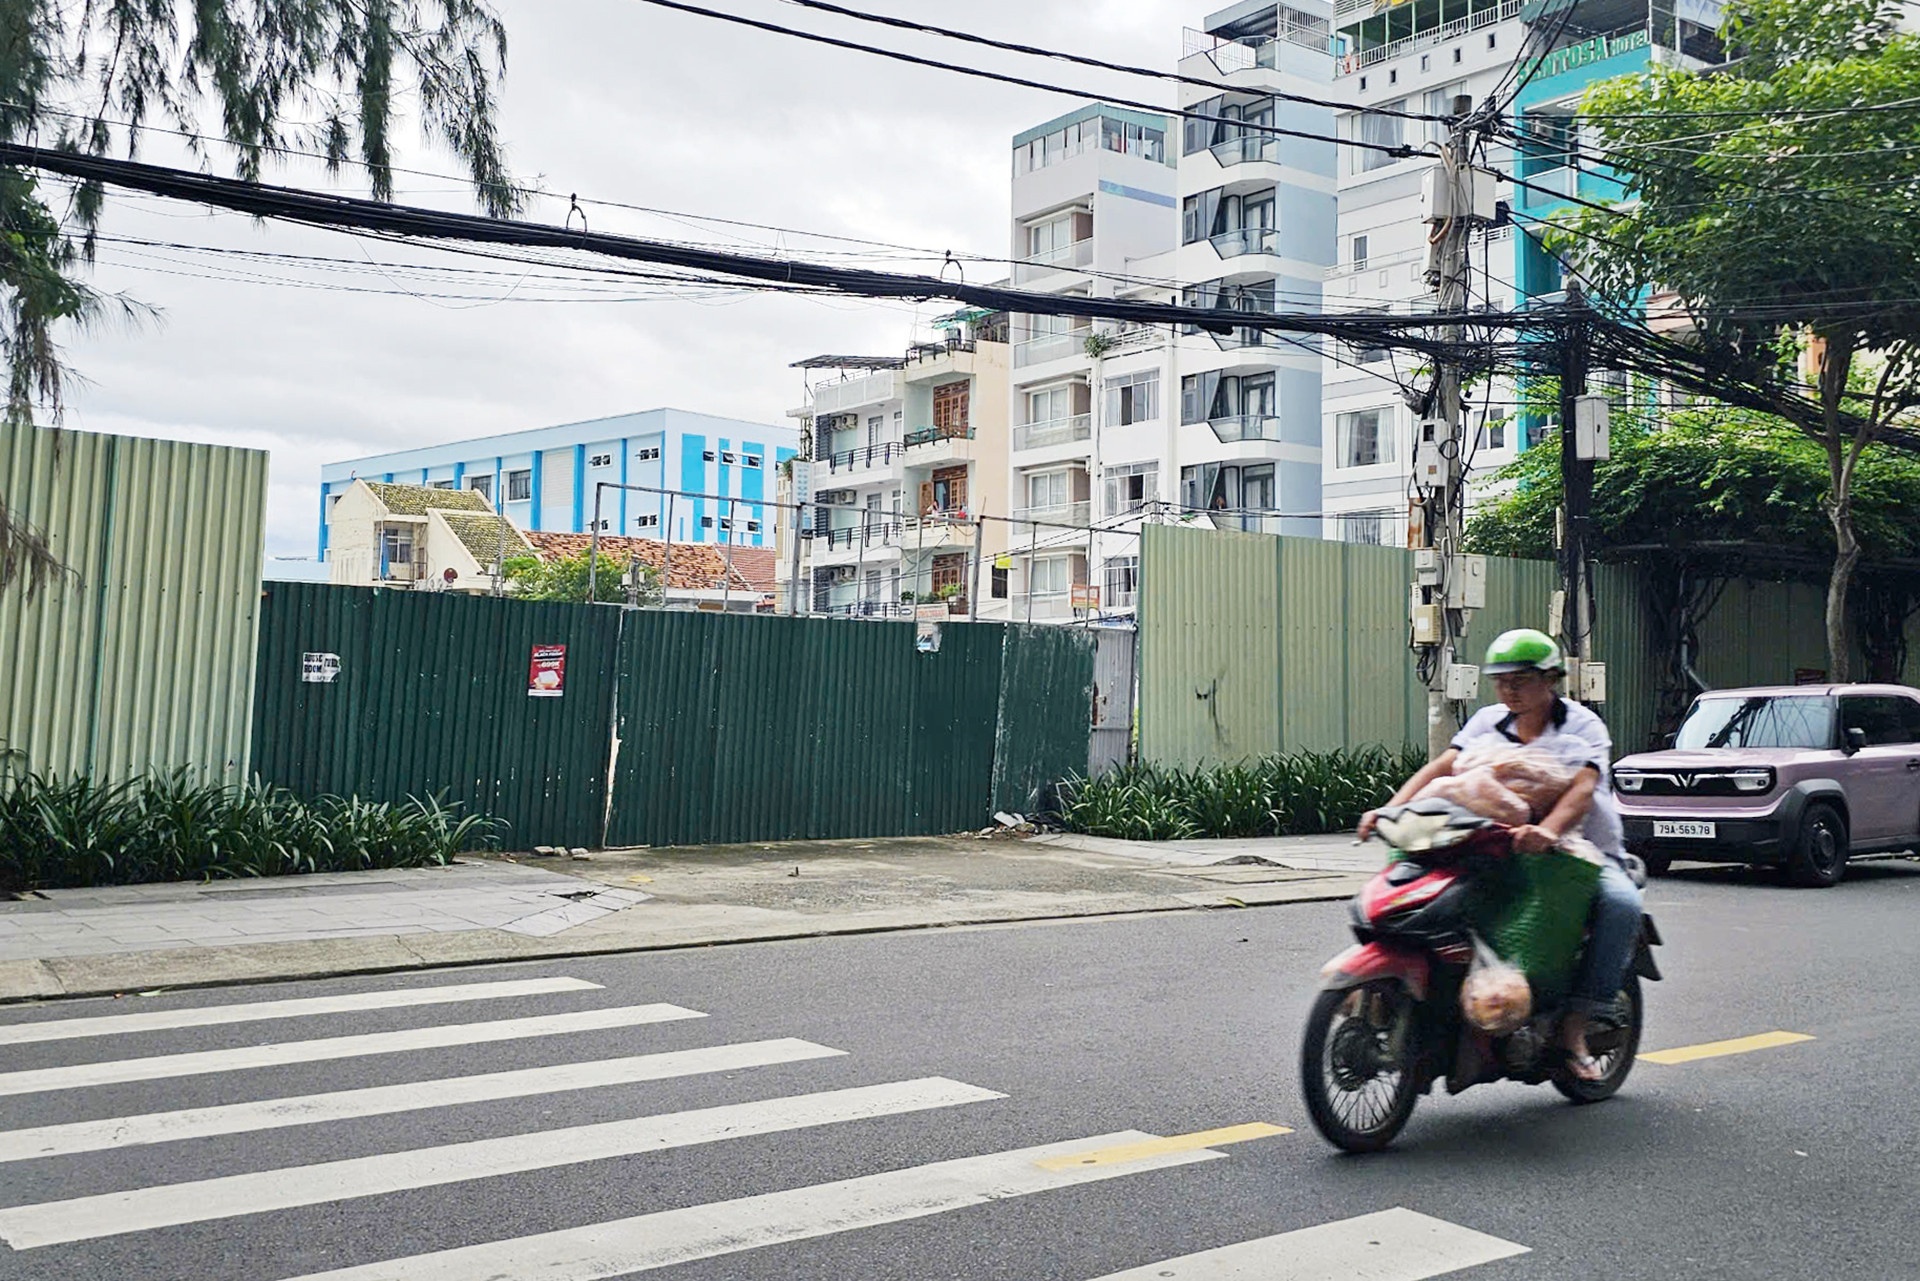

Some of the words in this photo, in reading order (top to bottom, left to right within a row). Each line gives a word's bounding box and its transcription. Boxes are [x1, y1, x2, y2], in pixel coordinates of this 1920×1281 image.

[1517, 36, 1608, 86] SANTOSA
[1610, 29, 1650, 56] HOTEL
[1659, 824, 1710, 835] 79A-569.78
